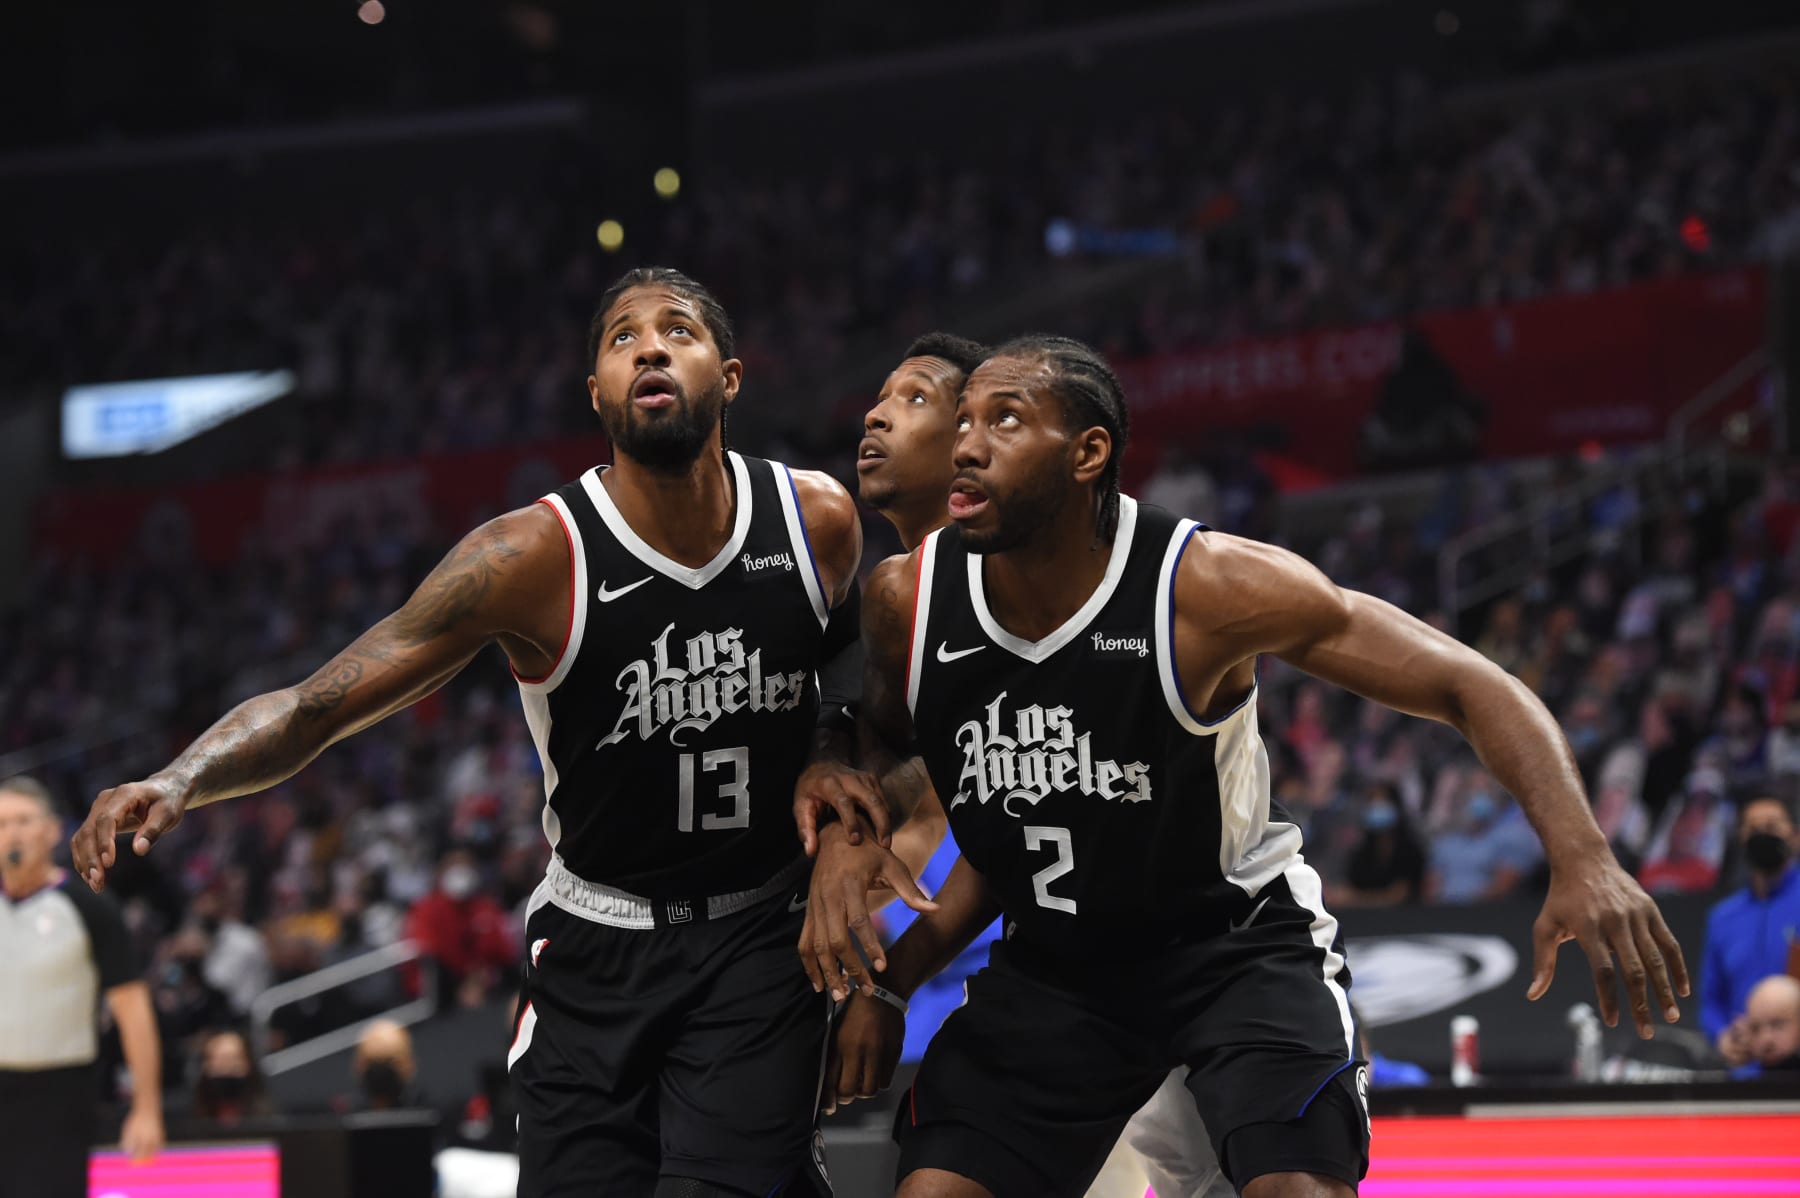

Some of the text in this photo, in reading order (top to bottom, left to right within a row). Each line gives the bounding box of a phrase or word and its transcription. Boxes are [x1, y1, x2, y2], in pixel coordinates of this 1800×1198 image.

[741, 551, 795, 572] honey
[651, 622, 745, 685] Los
[1090, 632, 1149, 657] honey
[596, 647, 807, 751] Angeles
[984, 690, 1076, 751] Los
[677, 746, 750, 832] 13
[950, 731, 1152, 818] Angeles
[1023, 825, 1077, 915] 2
